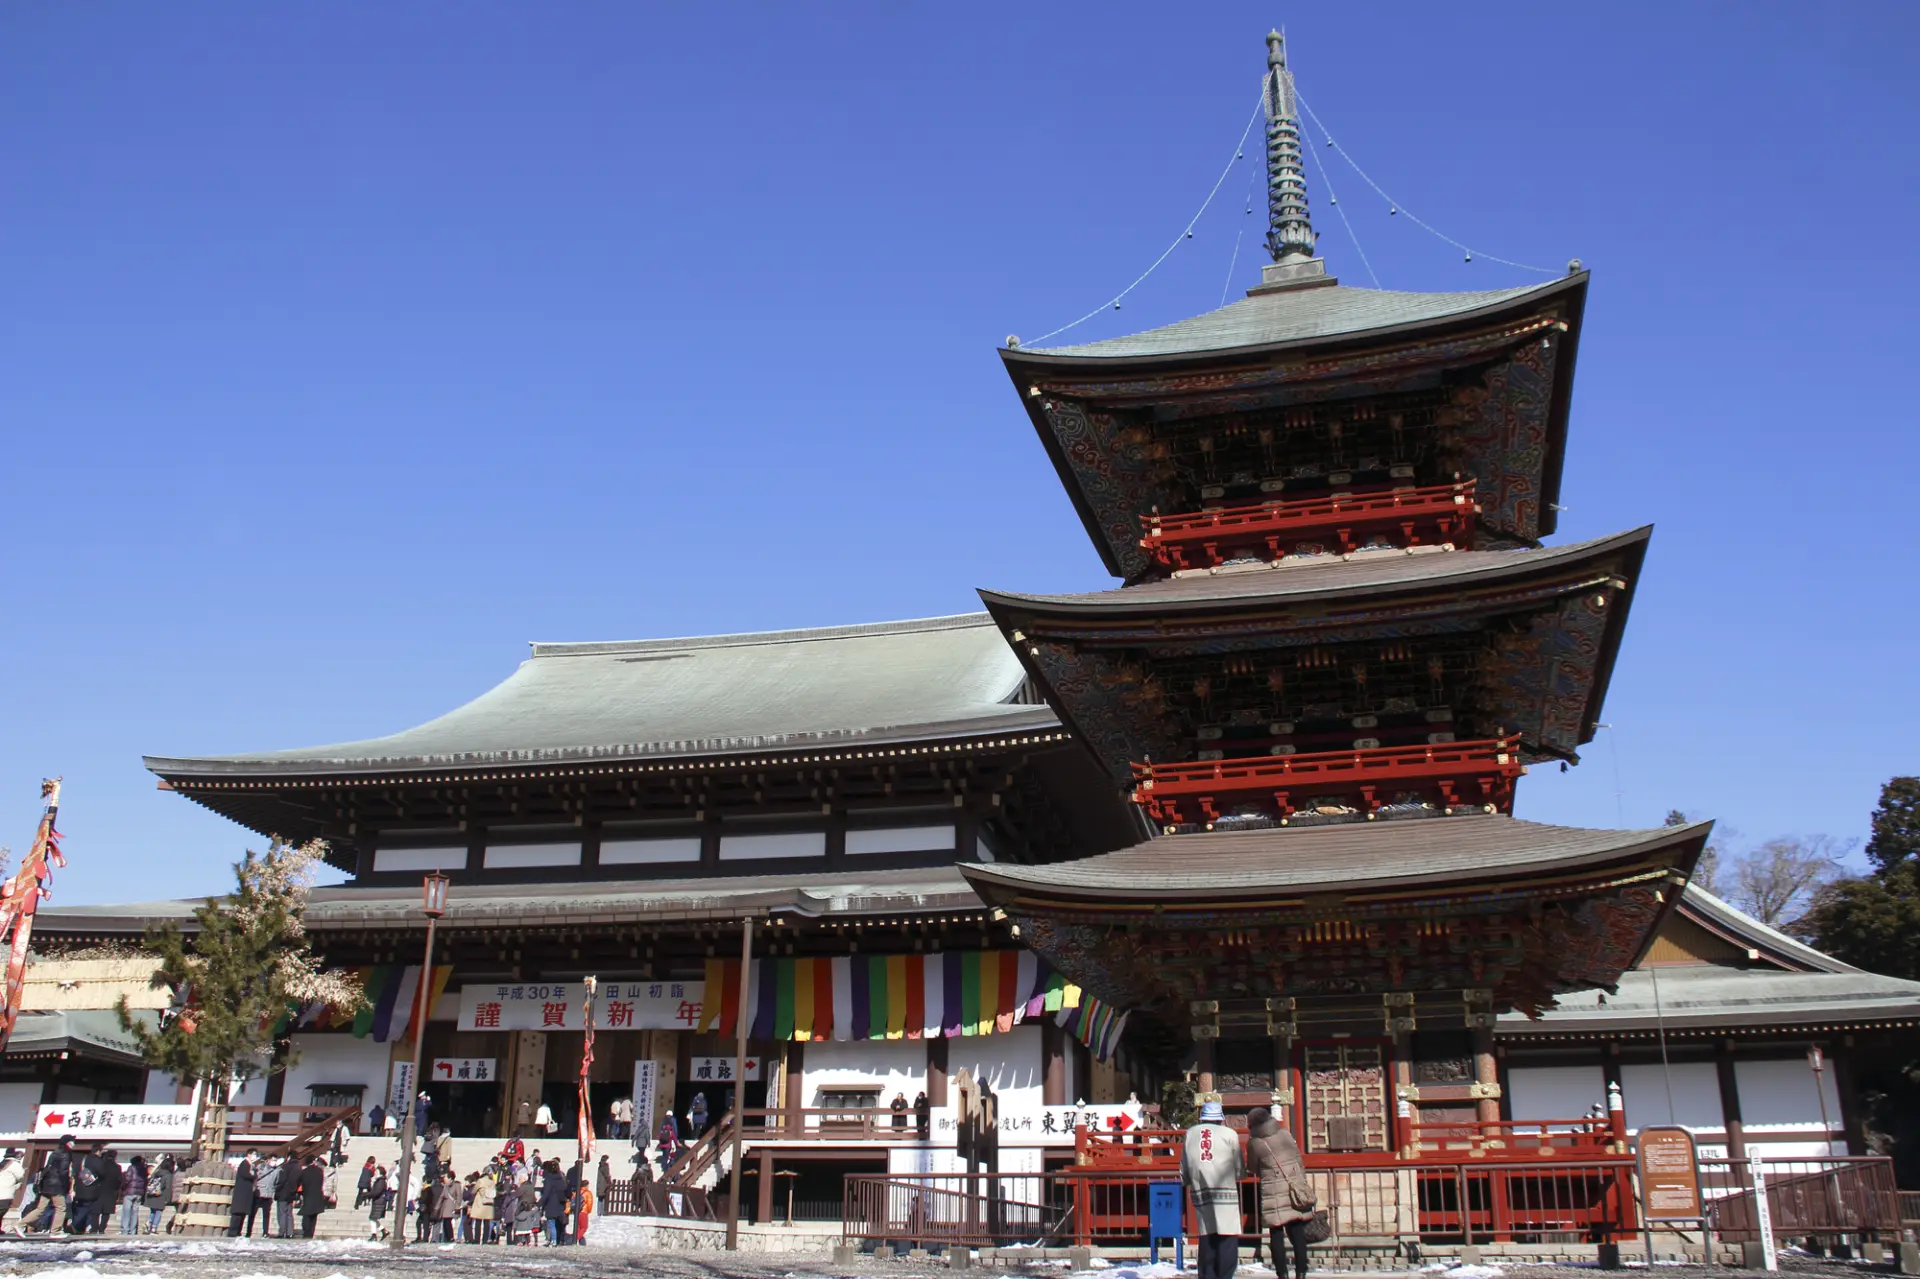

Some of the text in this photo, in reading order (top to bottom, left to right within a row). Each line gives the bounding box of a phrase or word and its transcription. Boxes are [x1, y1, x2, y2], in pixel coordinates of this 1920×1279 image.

[497, 985, 566, 1001] 平成30年
[474, 1000, 704, 1028] 謹賀新年
[457, 1067, 488, 1080] 順路
[696, 1066, 732, 1080] 順路
[67, 1109, 114, 1129] 西翼殿
[1041, 1111, 1100, 1135] 東翼殿
